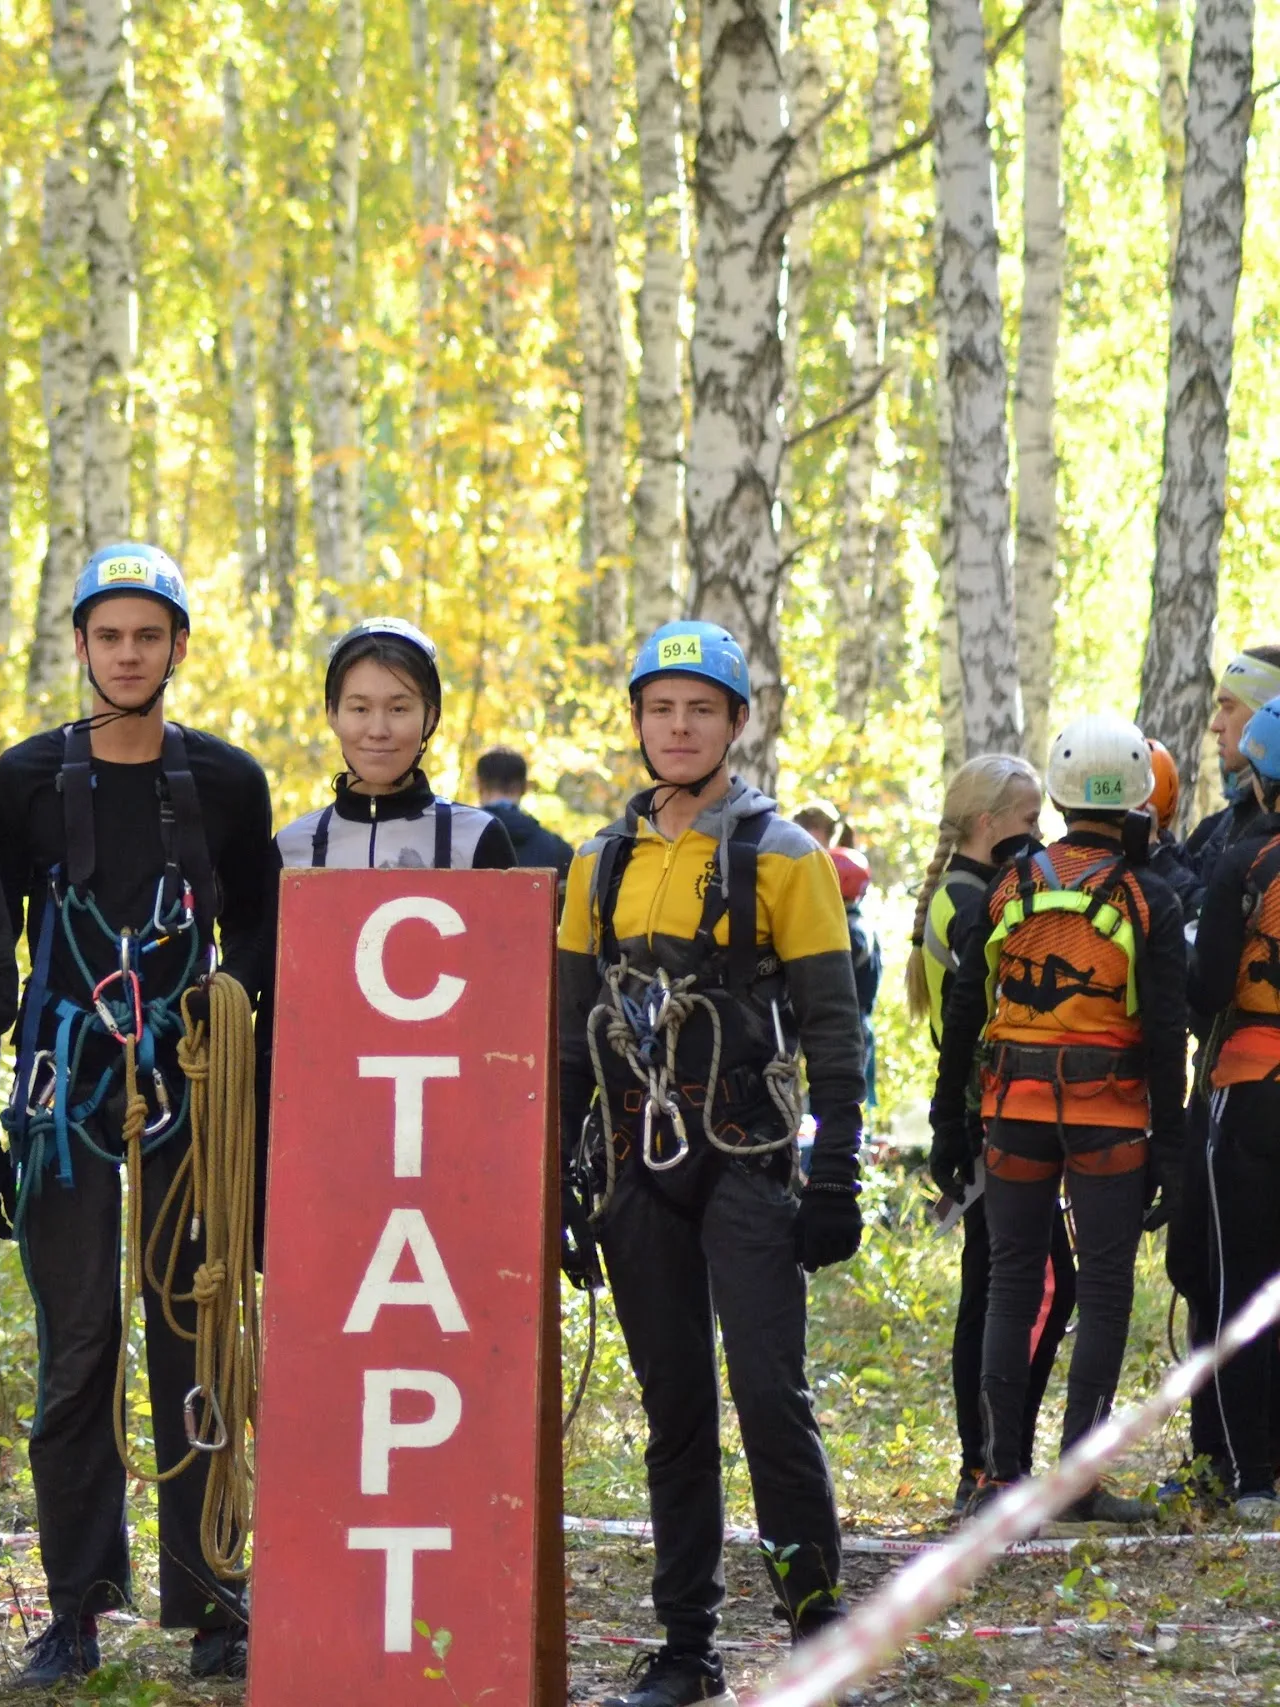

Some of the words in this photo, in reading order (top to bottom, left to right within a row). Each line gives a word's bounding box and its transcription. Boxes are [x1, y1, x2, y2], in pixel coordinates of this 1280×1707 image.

[108, 562, 143, 577] 59.3
[663, 641, 697, 659] 59.4
[1093, 779, 1122, 797] 36.4
[342, 896, 470, 1653] СТАРТ
